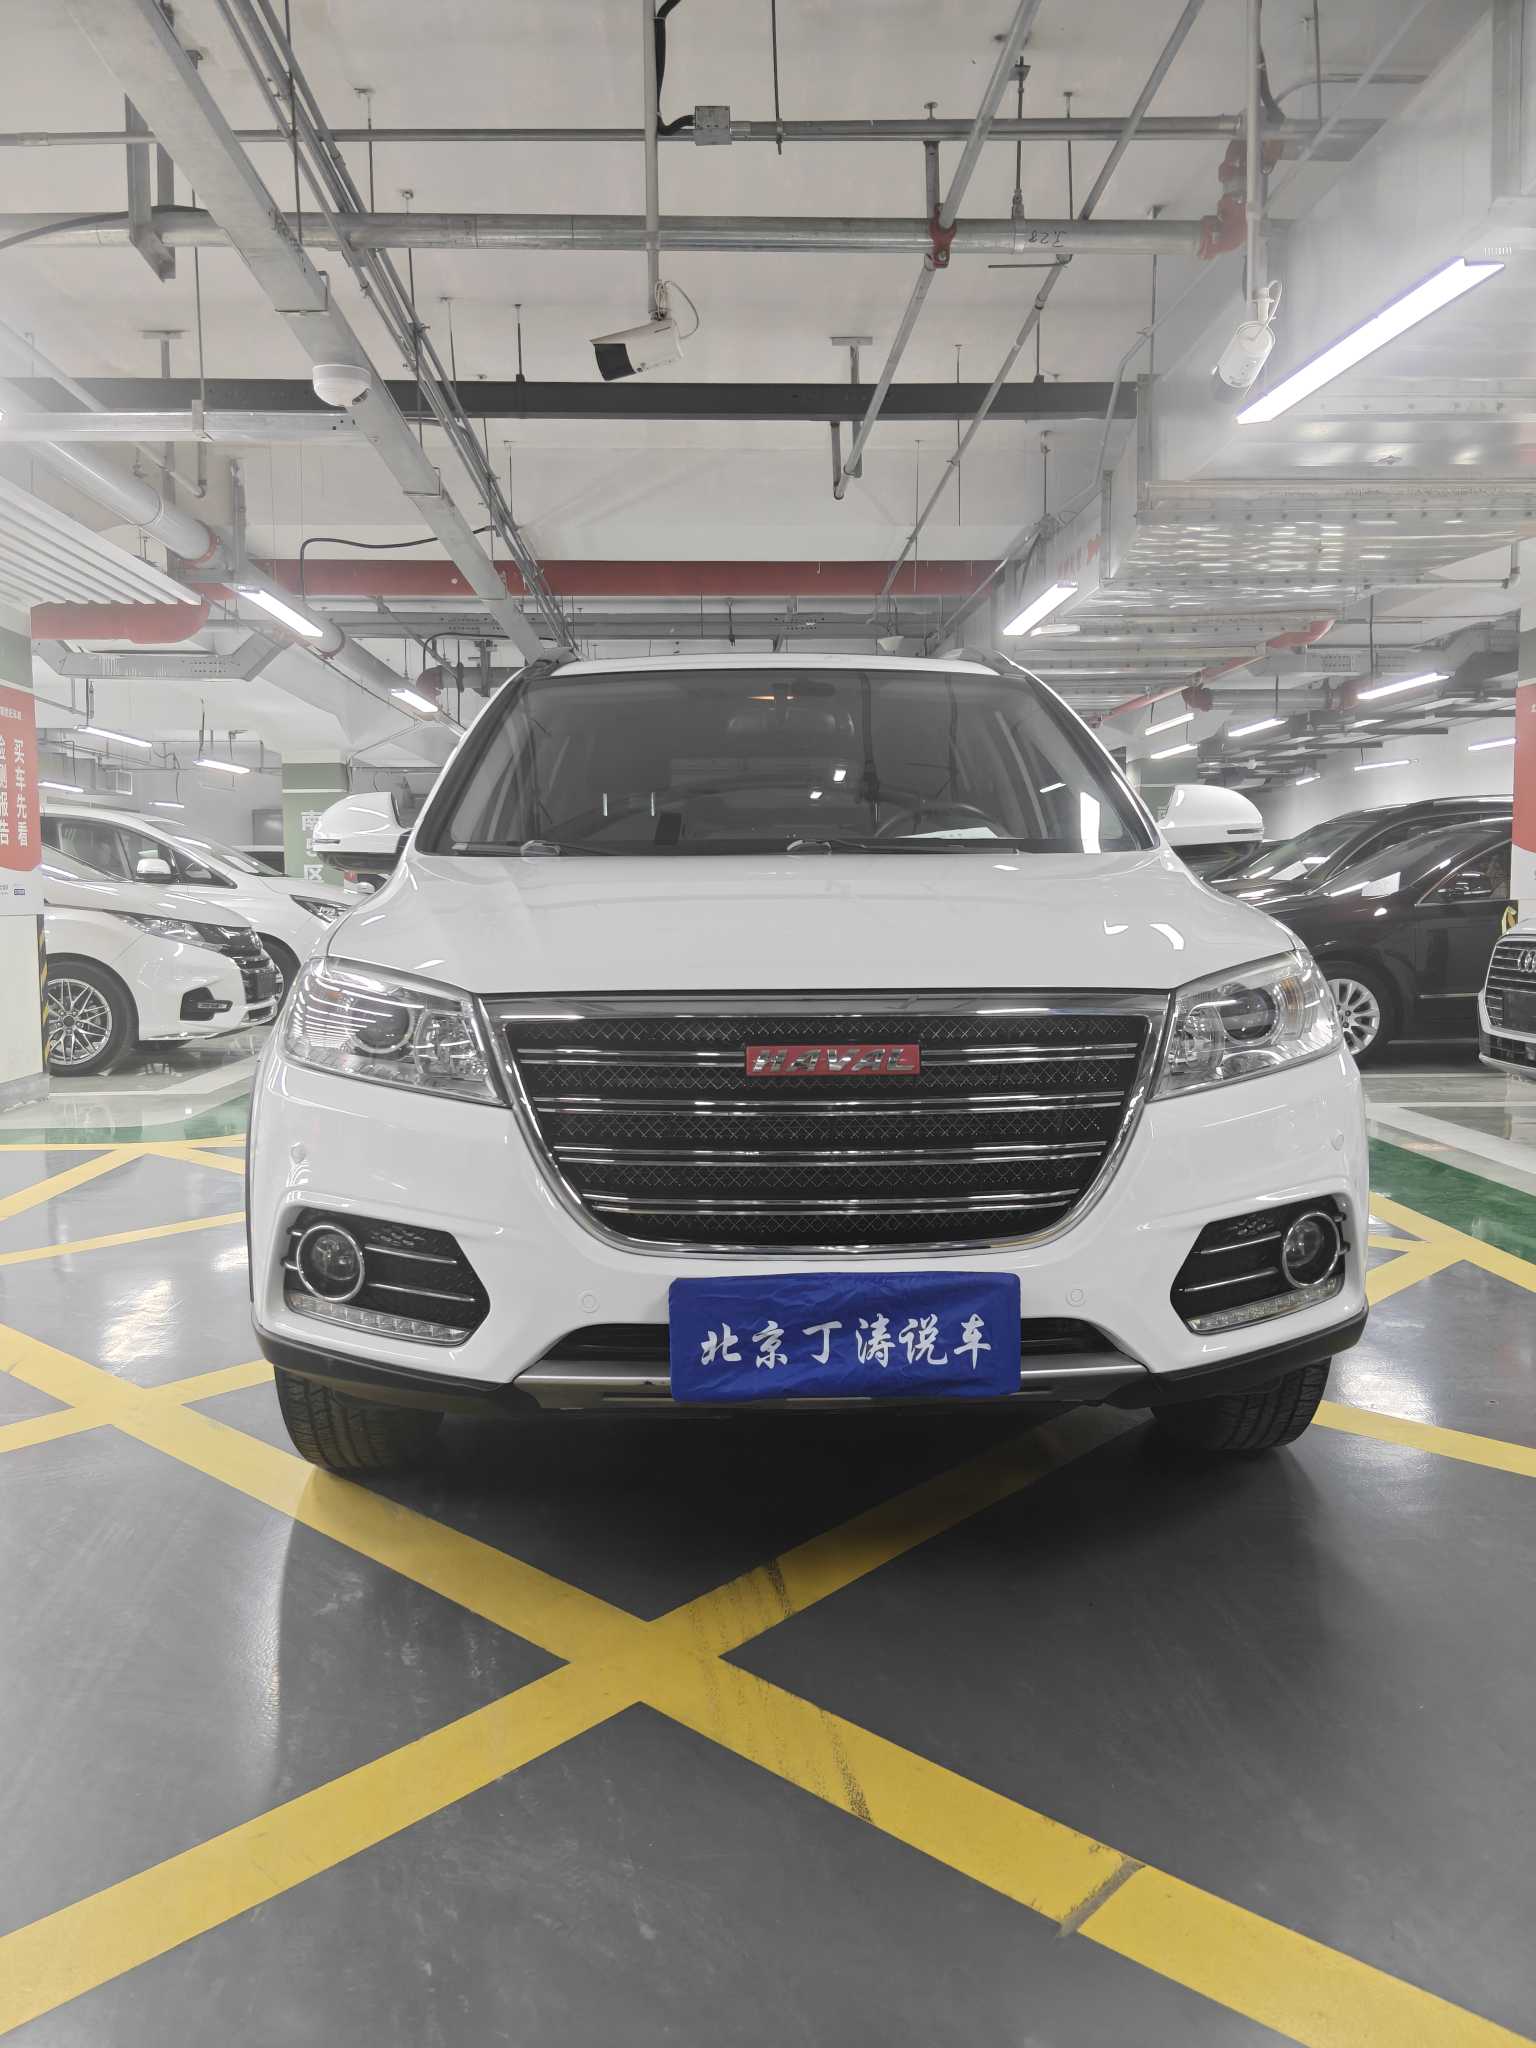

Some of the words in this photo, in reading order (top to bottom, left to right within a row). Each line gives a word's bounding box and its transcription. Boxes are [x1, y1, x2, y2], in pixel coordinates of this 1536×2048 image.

[14, 739, 28, 848] 买车先看
[752, 1047, 916, 1073] HAVAL
[701, 1312, 992, 1370] 北京丁涛说车
